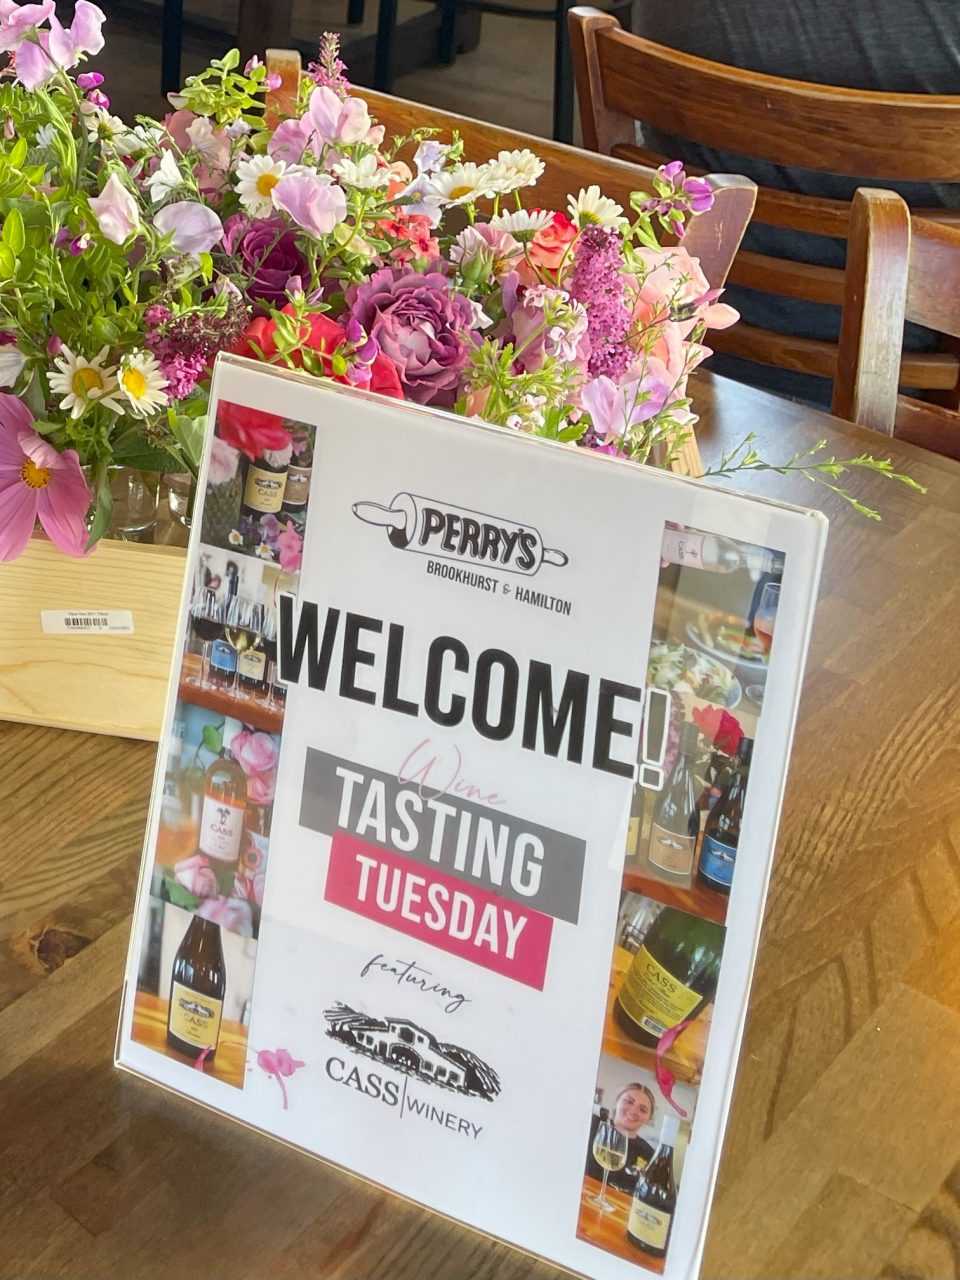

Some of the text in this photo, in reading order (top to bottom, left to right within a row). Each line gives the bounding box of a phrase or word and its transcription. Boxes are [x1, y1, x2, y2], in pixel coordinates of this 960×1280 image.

[419, 507, 538, 570] PERRY'S
[426, 559, 573, 617] BROOKHURST & HAMILTON
[277, 592, 672, 792] WELCOME!
[397, 738, 507, 805] Wine
[335, 766, 545, 898] TASTING
[355, 853, 528, 961] TUESDAY
[360, 953, 472, 1013] featuring
[646, 962, 677, 993] CASS
[325, 1056, 483, 1140] CASS WINERY
